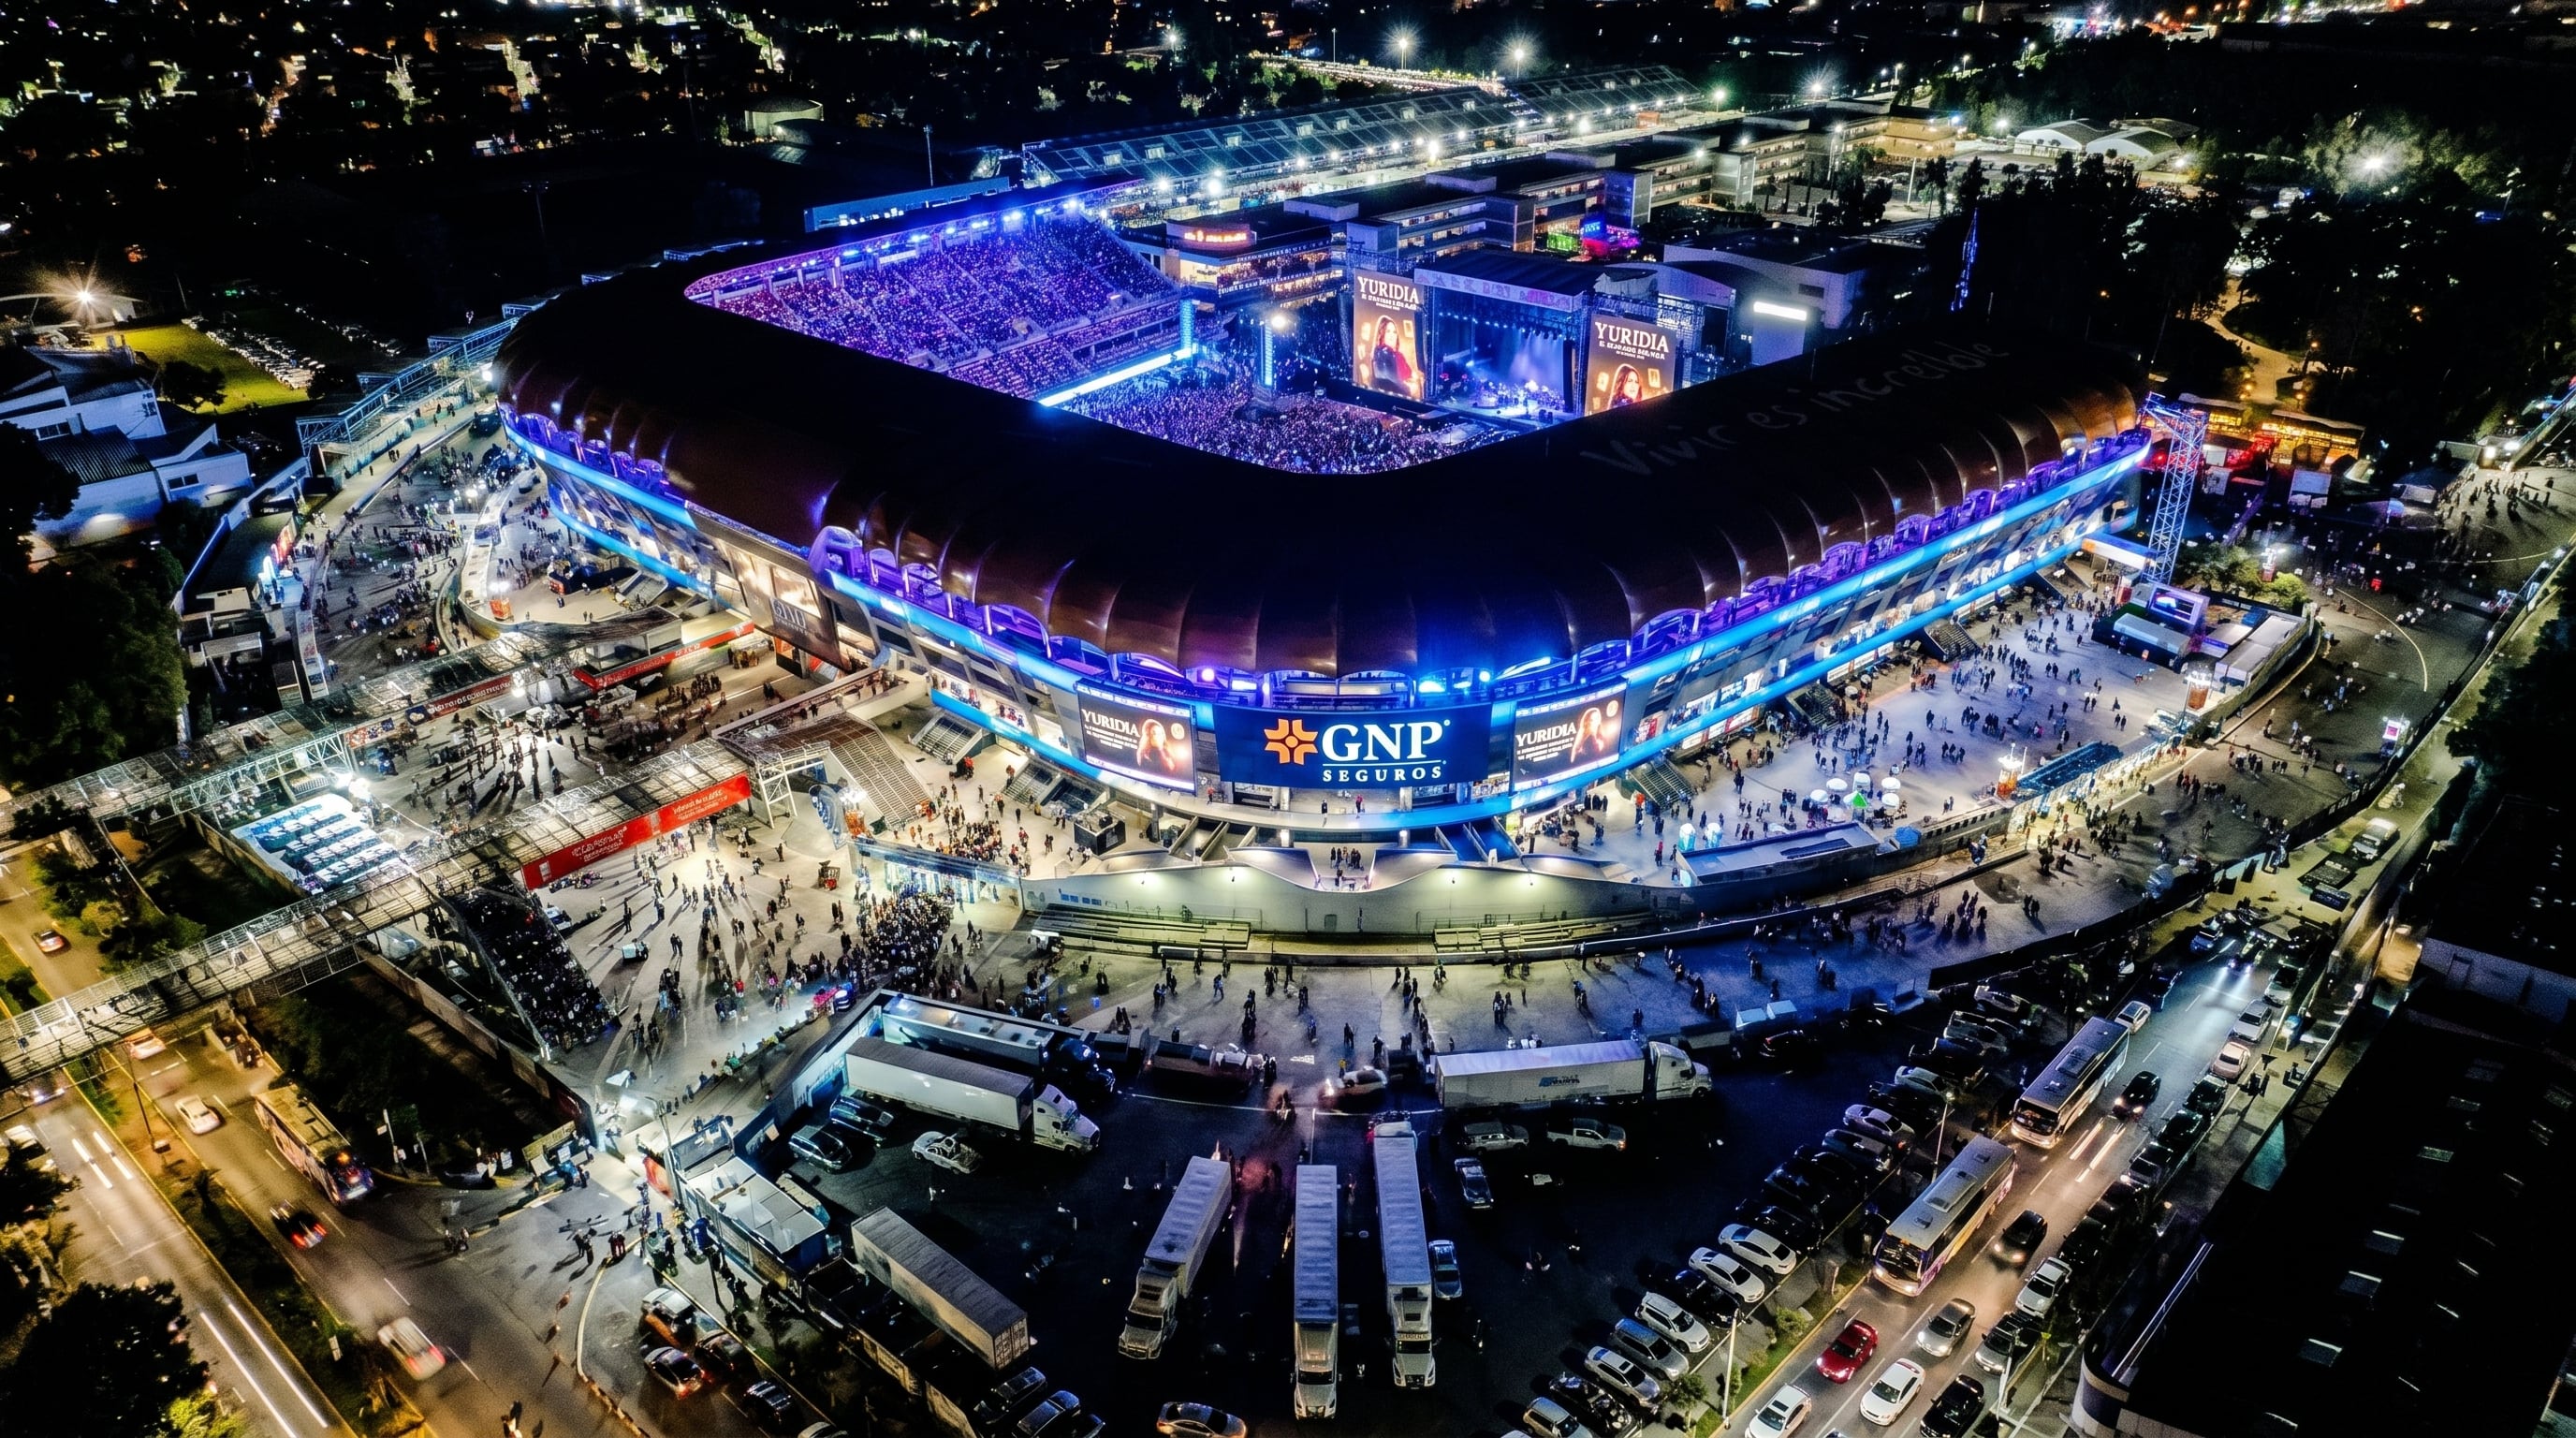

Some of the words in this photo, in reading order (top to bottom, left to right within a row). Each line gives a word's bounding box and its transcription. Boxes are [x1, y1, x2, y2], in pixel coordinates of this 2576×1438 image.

[1356, 275, 1420, 305] YURIDIA
[1594, 321, 1670, 353] YURIDIA
[1747, 404, 1808, 430] es
[1081, 708, 1141, 738] YURIDIA
[1515, 722, 1577, 748] YURIDIA
[1322, 765, 1442, 783] SEGUROS
